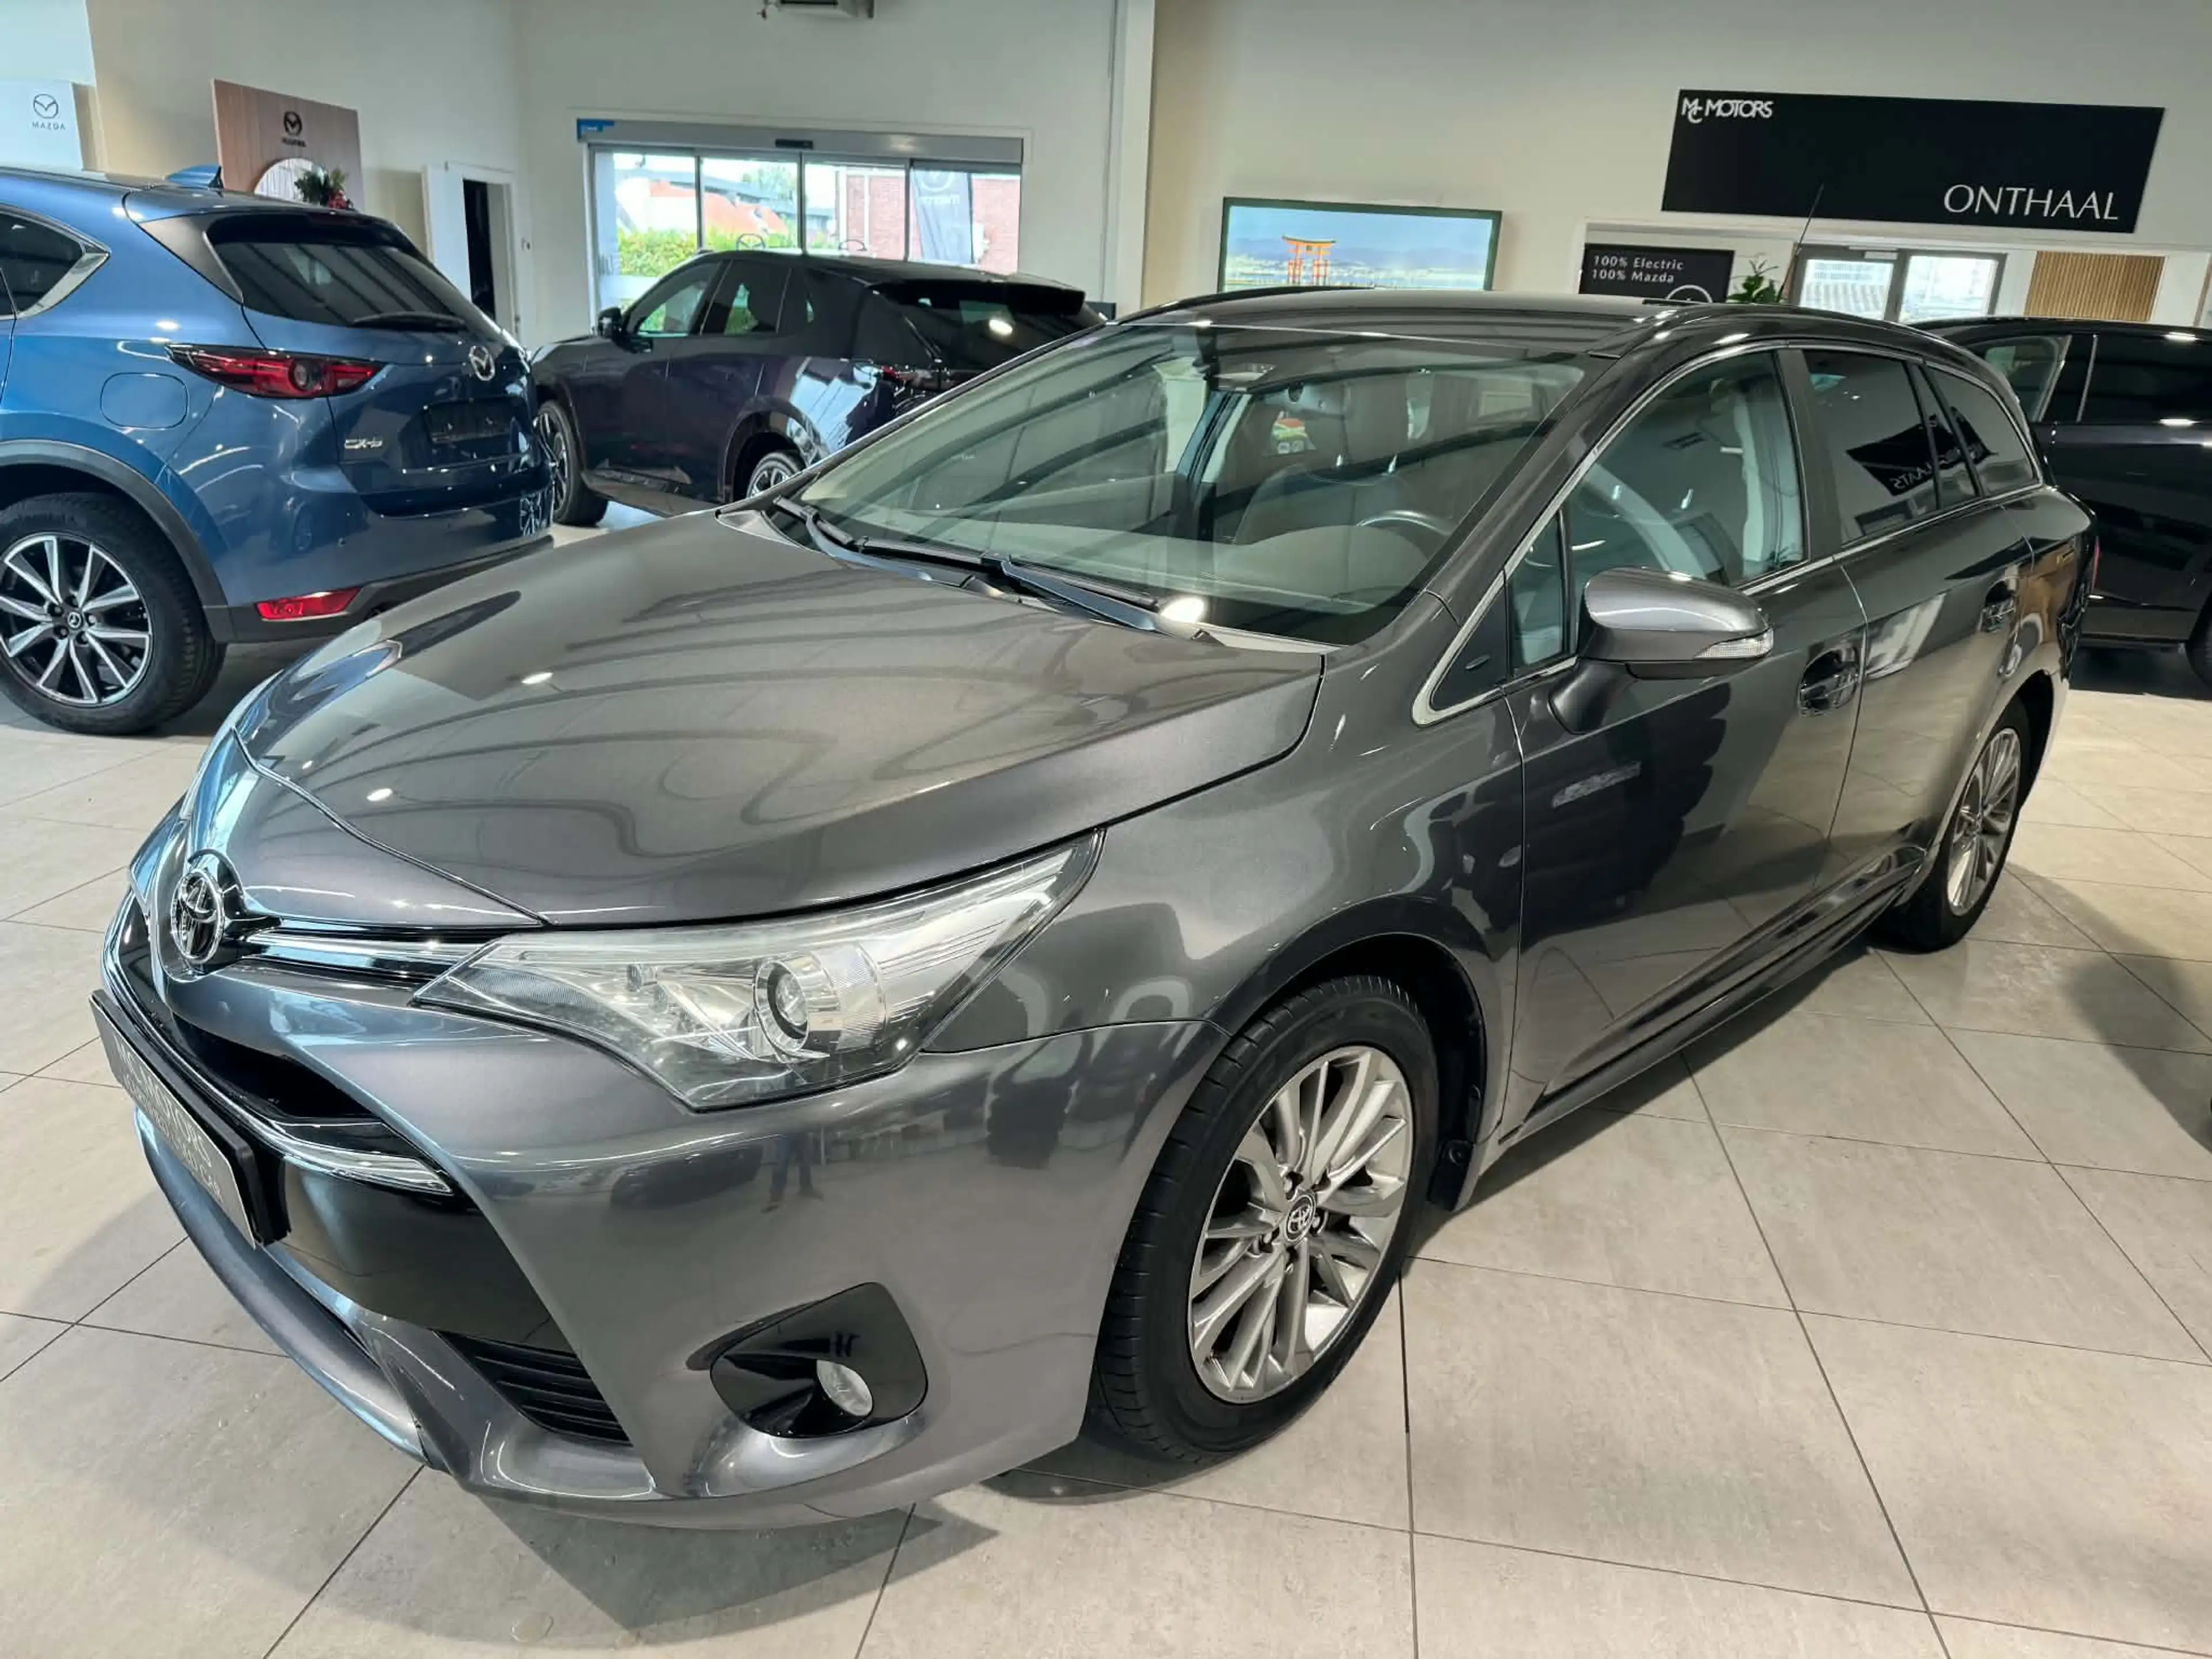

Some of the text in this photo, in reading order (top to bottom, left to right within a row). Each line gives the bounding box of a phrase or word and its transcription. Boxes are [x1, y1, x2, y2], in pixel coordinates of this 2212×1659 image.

[1705, 98, 1774, 119] MOTORS
[32, 121, 66, 130] MAZDA
[1944, 184, 2118, 220] ONTHAAL
[1593, 255, 1684, 270] 100% Electric
[1592, 269, 1675, 283] 100% Mazda
